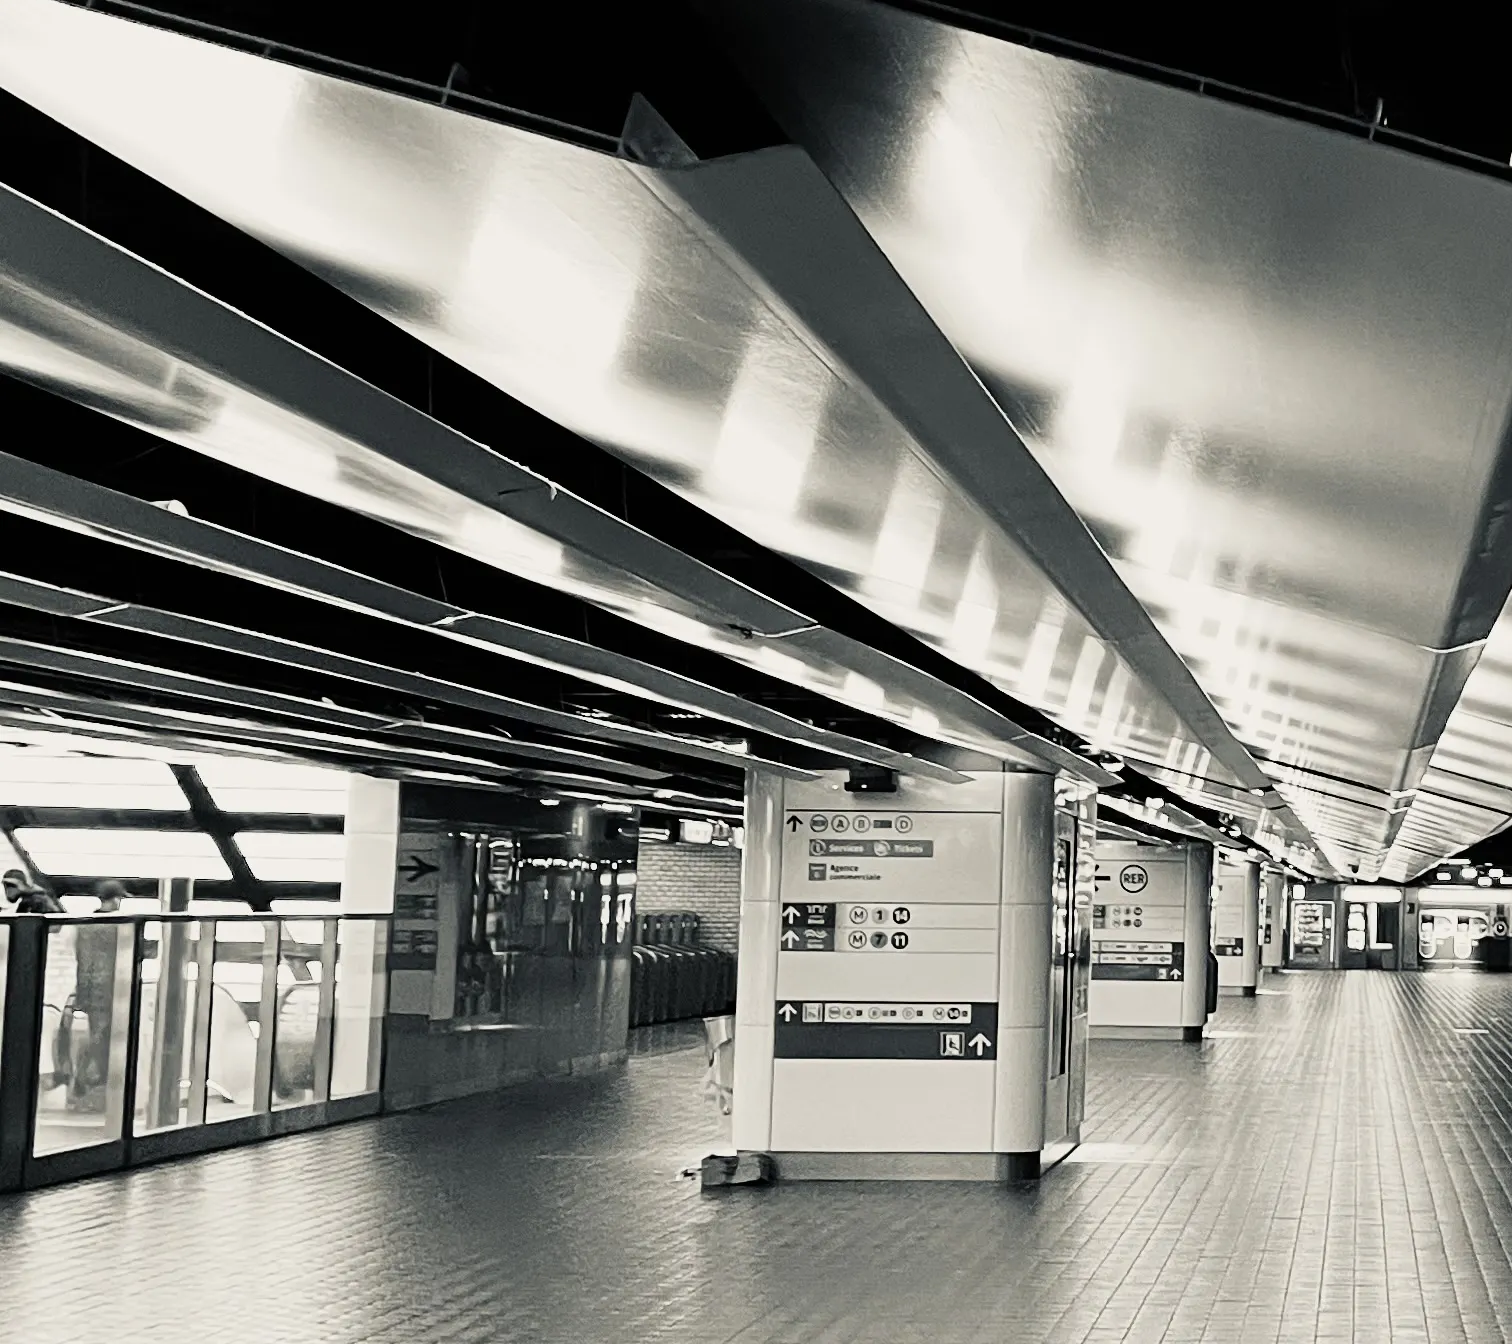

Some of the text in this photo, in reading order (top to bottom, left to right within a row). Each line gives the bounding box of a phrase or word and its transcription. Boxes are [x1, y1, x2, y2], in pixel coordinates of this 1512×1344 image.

[1123, 873, 1145, 884] RER
[894, 910, 908, 922] 14
[894, 935, 906, 946] 11
